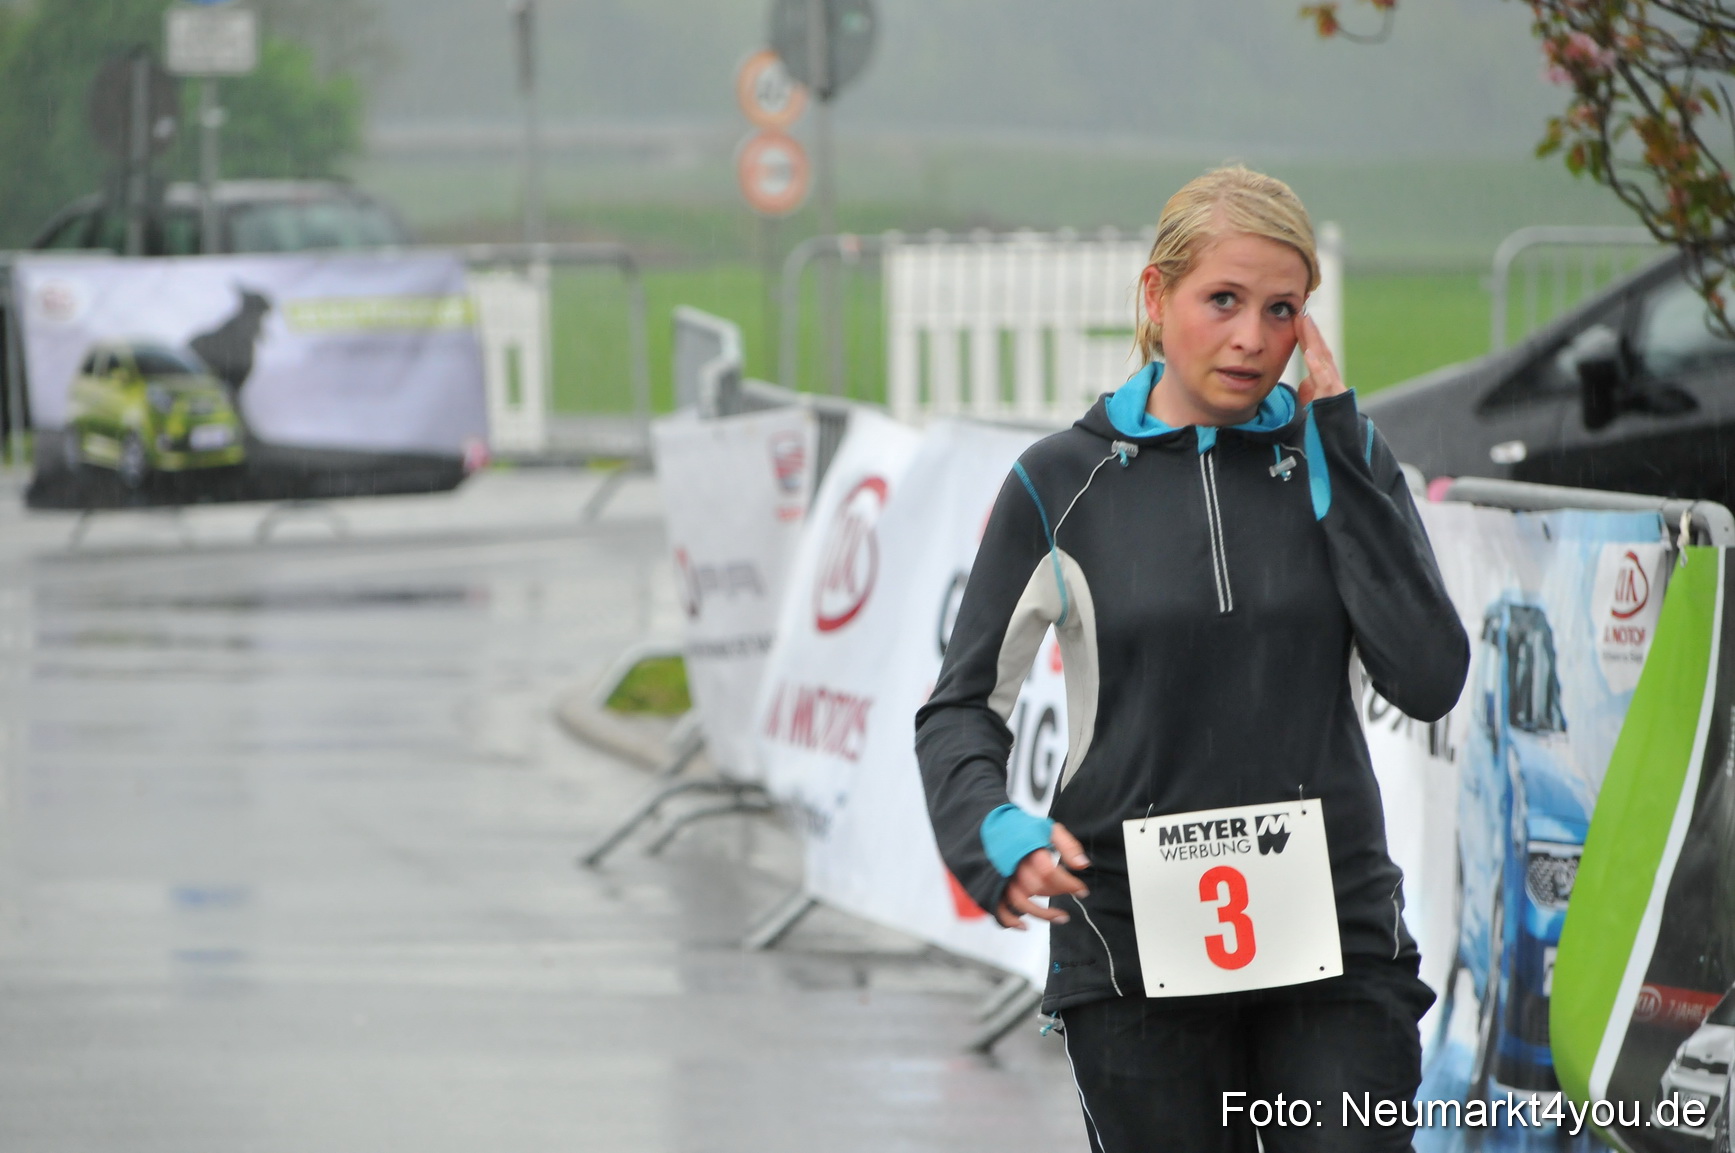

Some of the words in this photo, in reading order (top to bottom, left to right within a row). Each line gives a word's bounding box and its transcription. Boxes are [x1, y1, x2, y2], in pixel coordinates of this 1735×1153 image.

[1158, 816, 1249, 848] MEYER
[1160, 838, 1252, 863] WERBUNG
[1198, 864, 1257, 971] 3
